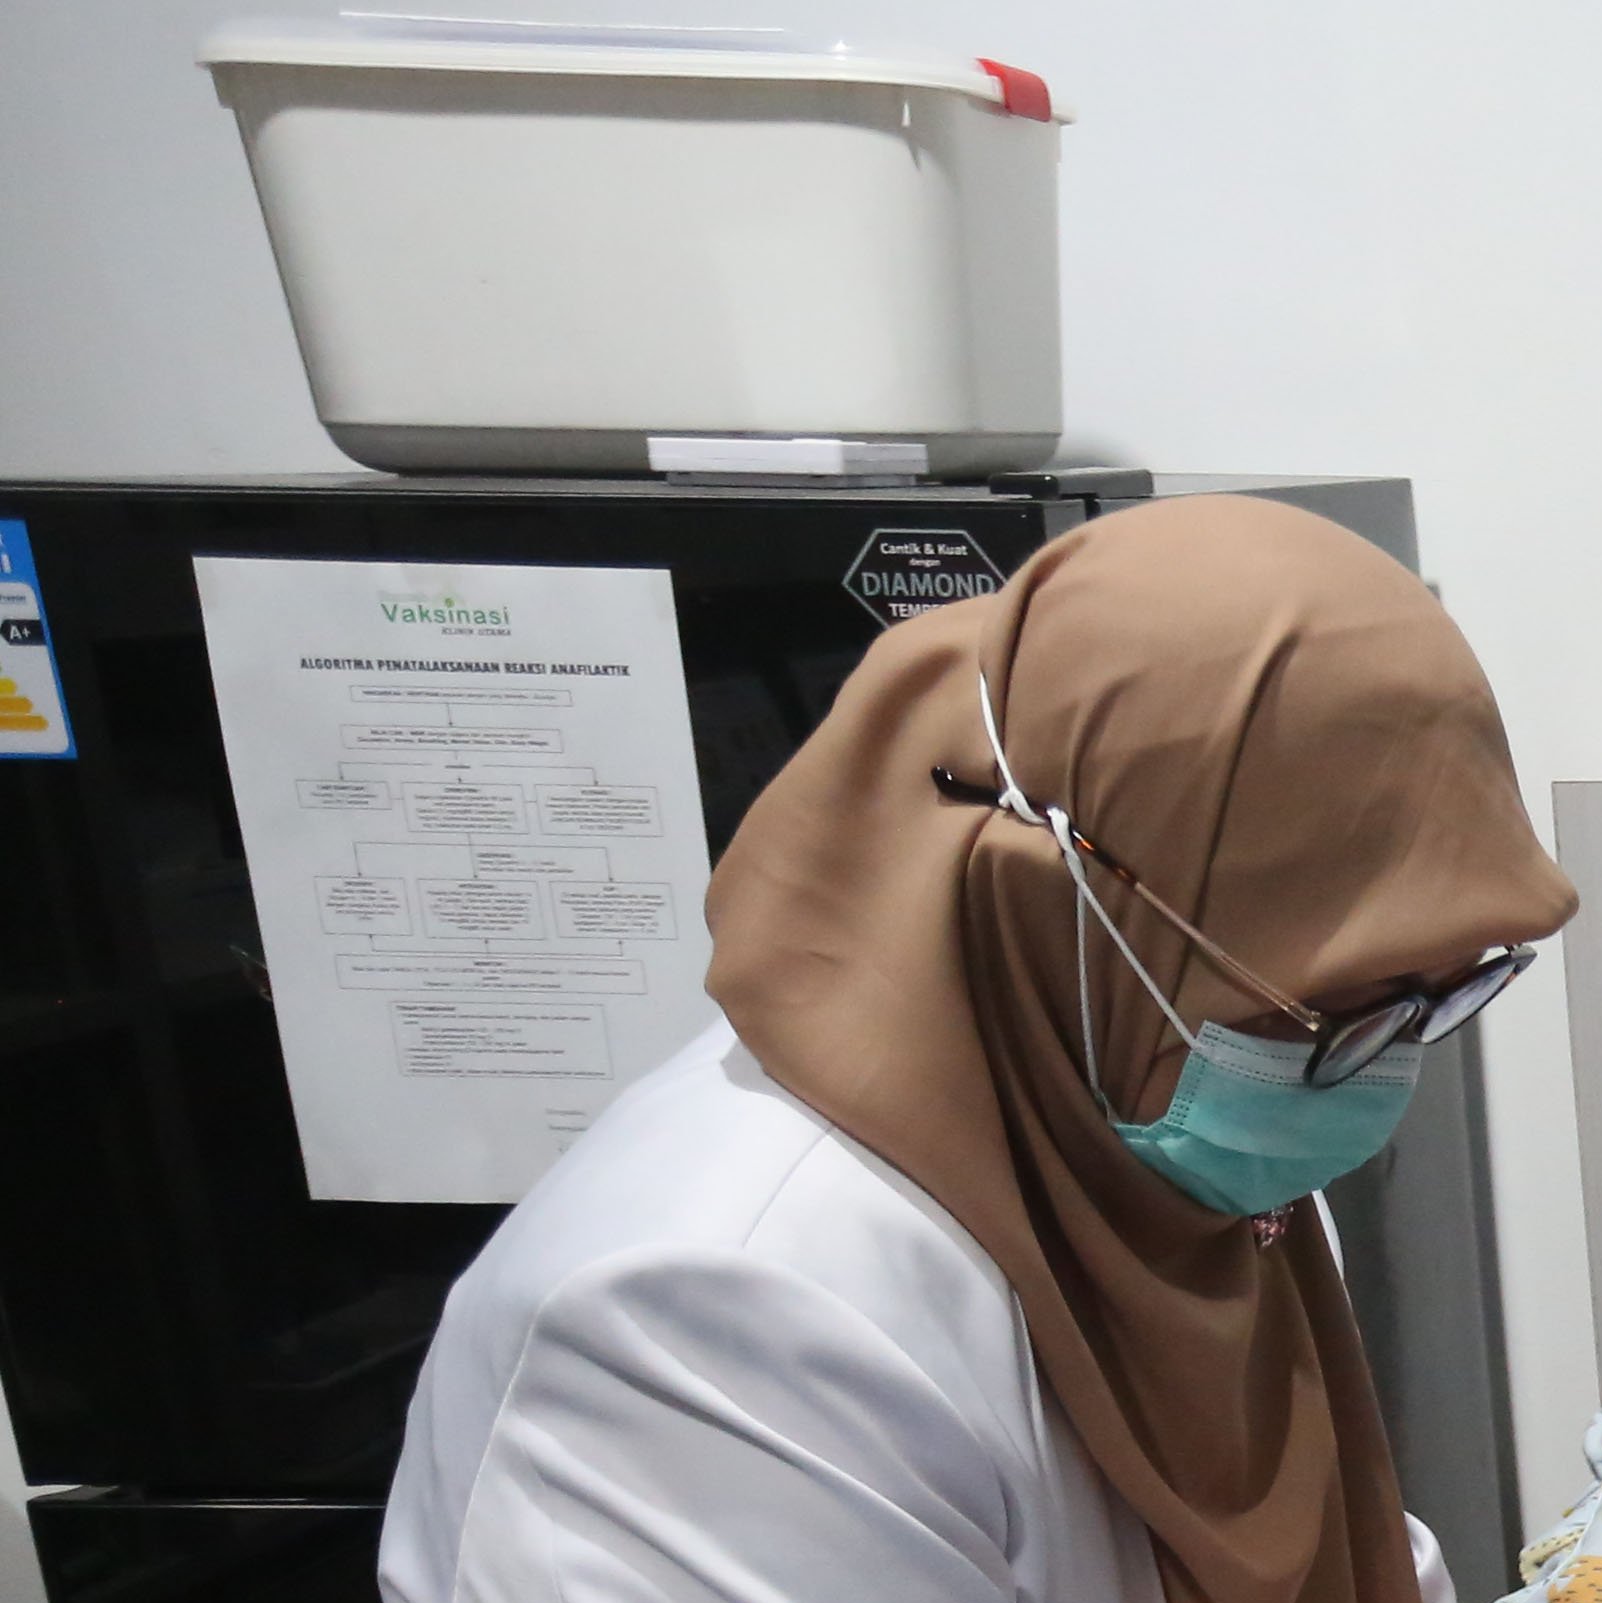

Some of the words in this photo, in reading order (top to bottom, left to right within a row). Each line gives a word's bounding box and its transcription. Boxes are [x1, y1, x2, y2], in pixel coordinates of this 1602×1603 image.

[880, 543, 921, 555] Cantik
[923, 544, 935, 555] &
[938, 544, 968, 555] Kuat
[909, 558, 941, 568] dengan
[861, 572, 996, 598] DIAMOND
[381, 598, 509, 625] Vaksinasi
[888, 603, 949, 617] TEMP
[10, 625, 31, 640] A+
[300, 658, 374, 671] ALGORITMA
[377, 659, 500, 673] PENATALAKSANAAN
[504, 662, 546, 675] REAKSI
[551, 663, 631, 677] ANAFILAKTIK
